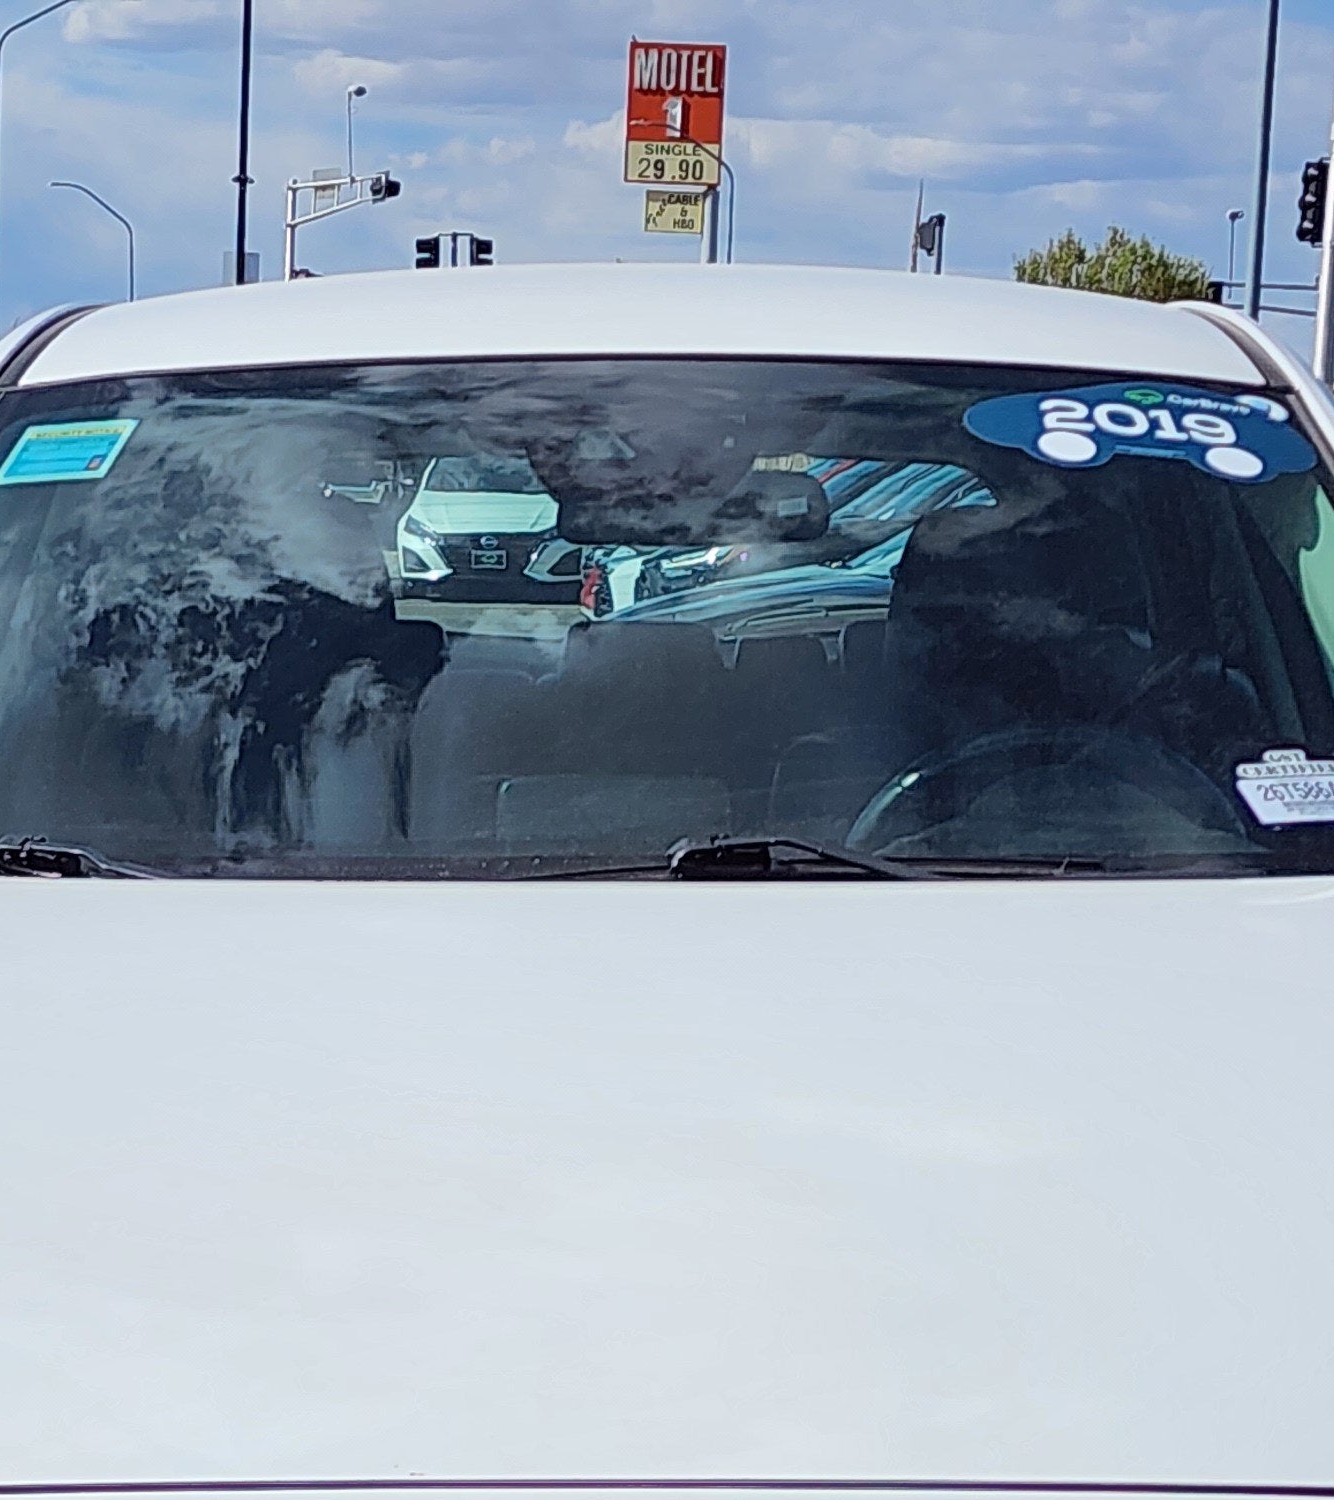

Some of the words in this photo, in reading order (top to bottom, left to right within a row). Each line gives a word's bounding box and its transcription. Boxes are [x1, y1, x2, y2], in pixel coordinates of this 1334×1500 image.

[632, 47, 719, 93] MOTEL
[661, 96, 683, 138] 1
[644, 142, 702, 157] SINGLE
[638, 157, 704, 181] 29.90
[667, 193, 701, 206] CABLE
[672, 218, 695, 230] HBO
[1038, 398, 1237, 446] 2019
